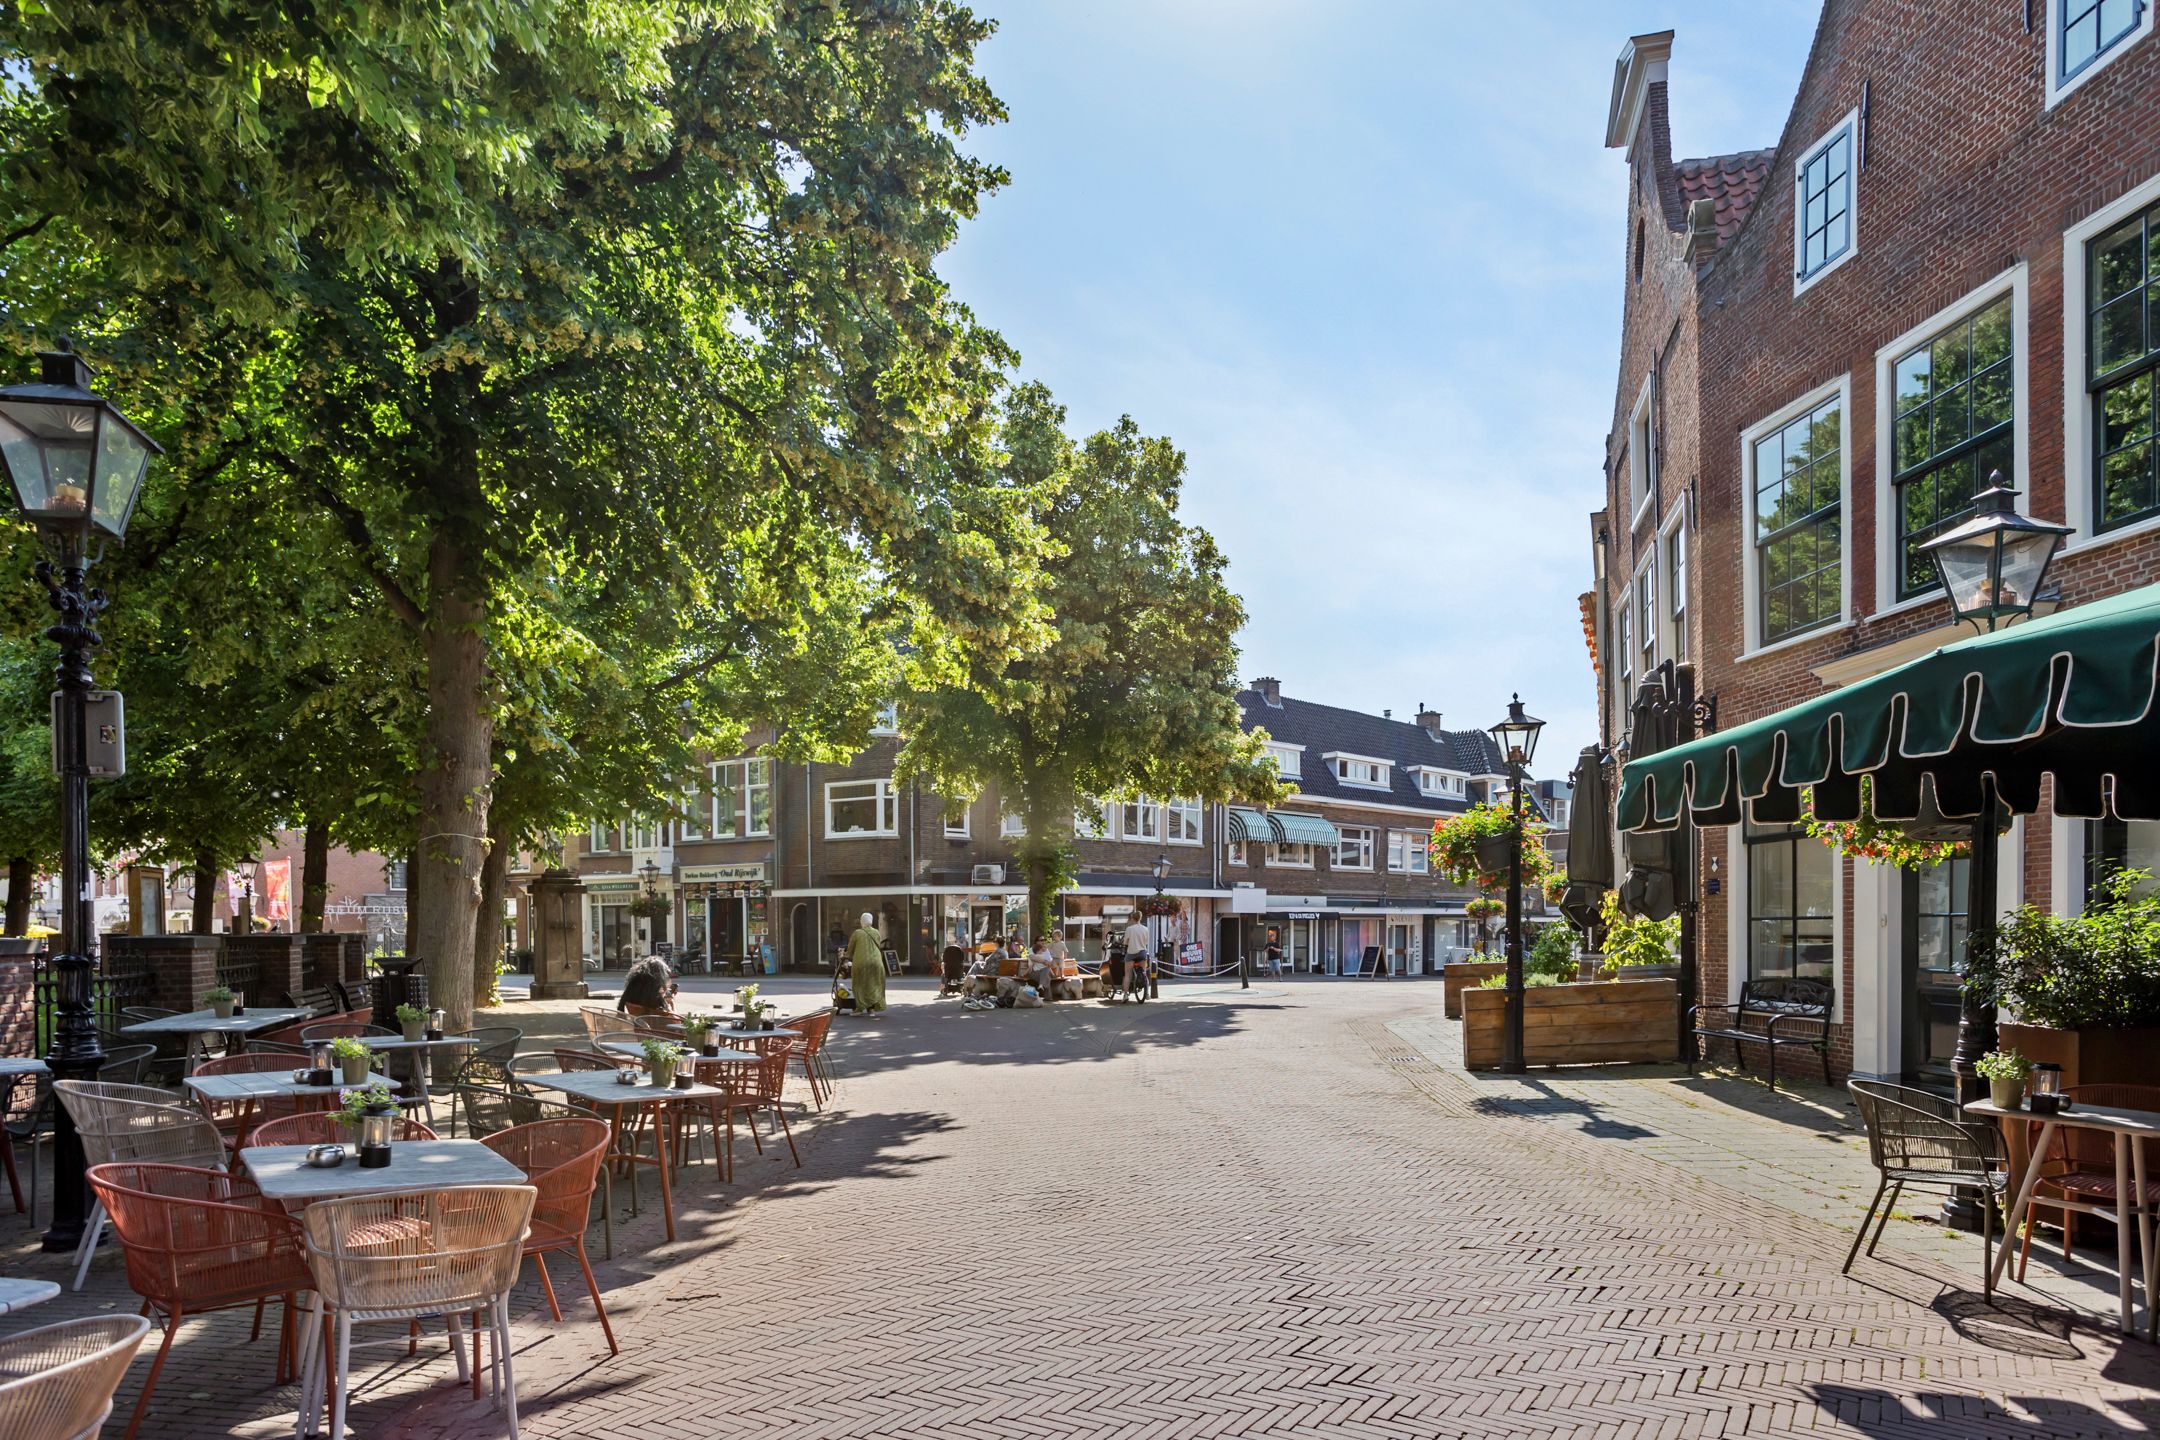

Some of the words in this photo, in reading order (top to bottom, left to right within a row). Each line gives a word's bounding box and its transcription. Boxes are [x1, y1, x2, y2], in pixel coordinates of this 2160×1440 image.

[327, 906, 367, 914] SEUM
[1181, 949, 1202, 958] NIEUWE
[1187, 955, 1202, 963] THUIS
